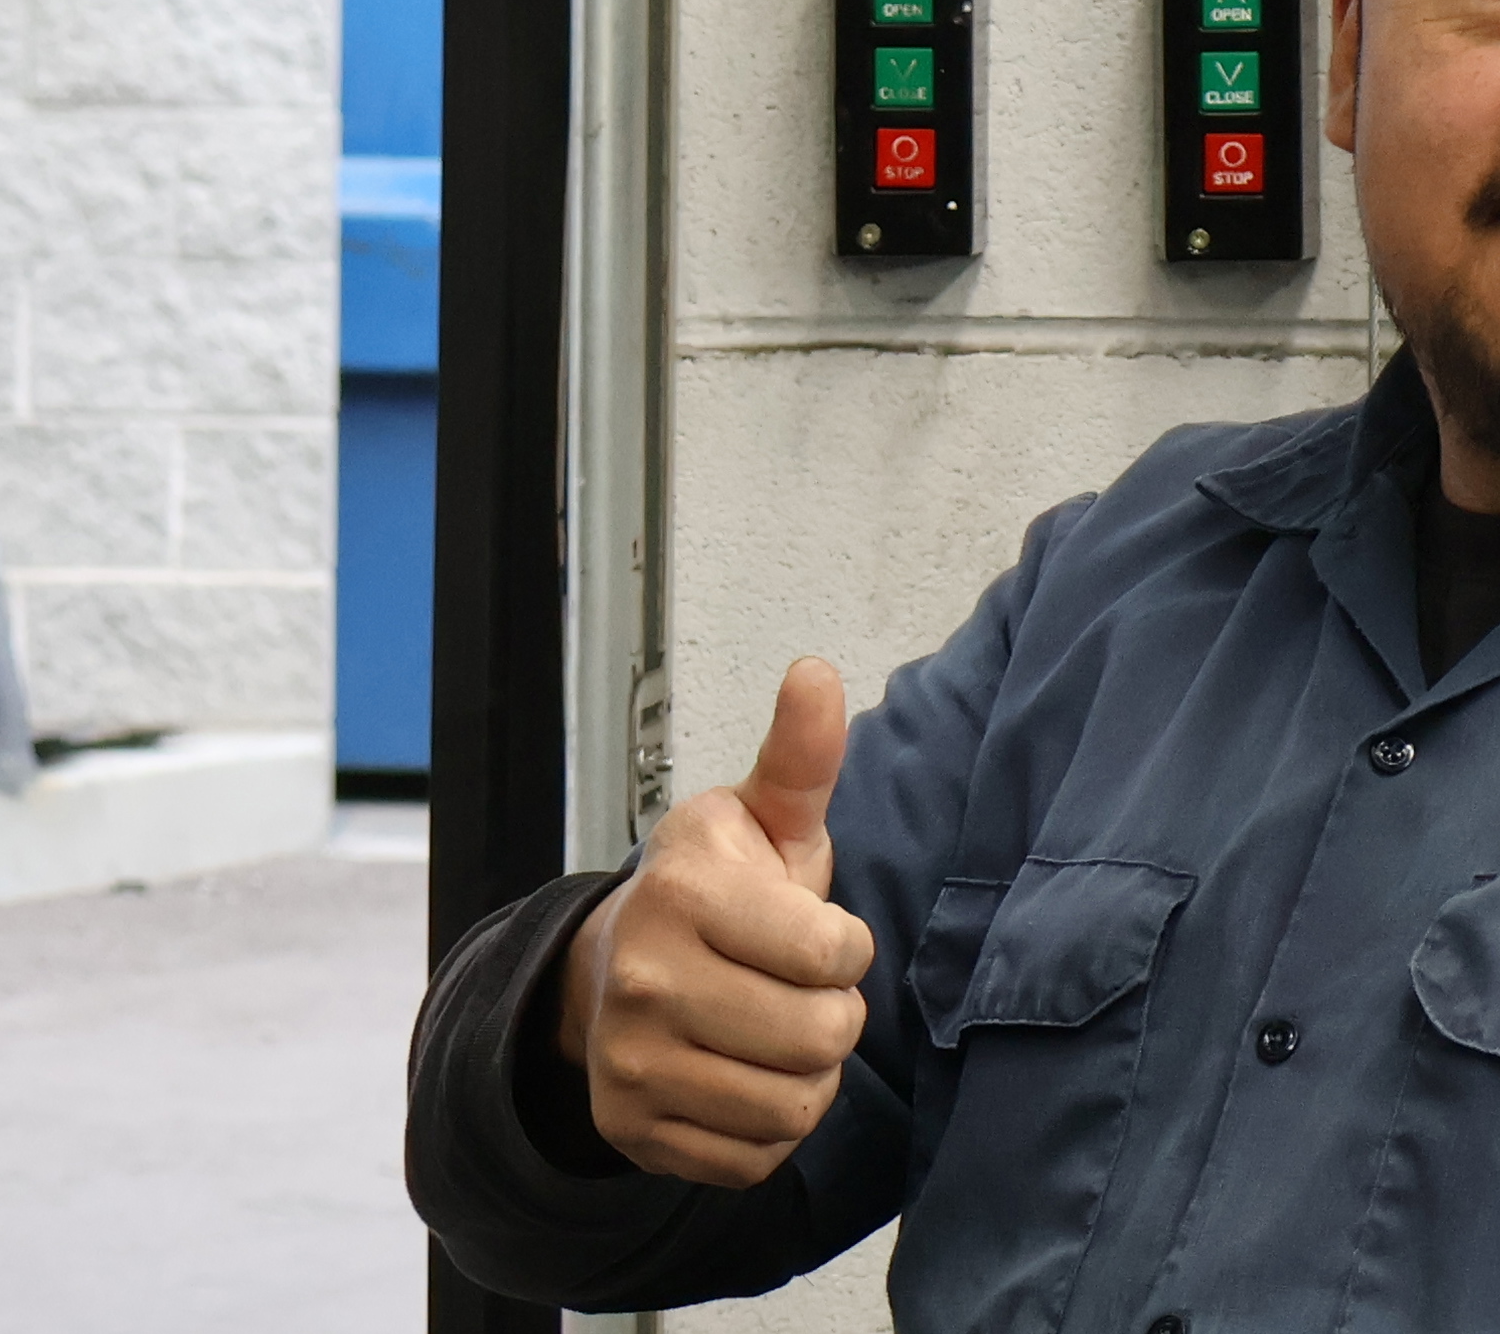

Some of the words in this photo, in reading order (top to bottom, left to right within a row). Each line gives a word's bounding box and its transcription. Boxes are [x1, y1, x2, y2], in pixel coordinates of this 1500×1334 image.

[882, 3, 924, 18] OPEN
[1210, 7, 1253, 22] OPEN
[1204, 89, 1256, 105] CLOSE
[884, 164, 925, 180] STOP
[1212, 170, 1255, 185] STOP
